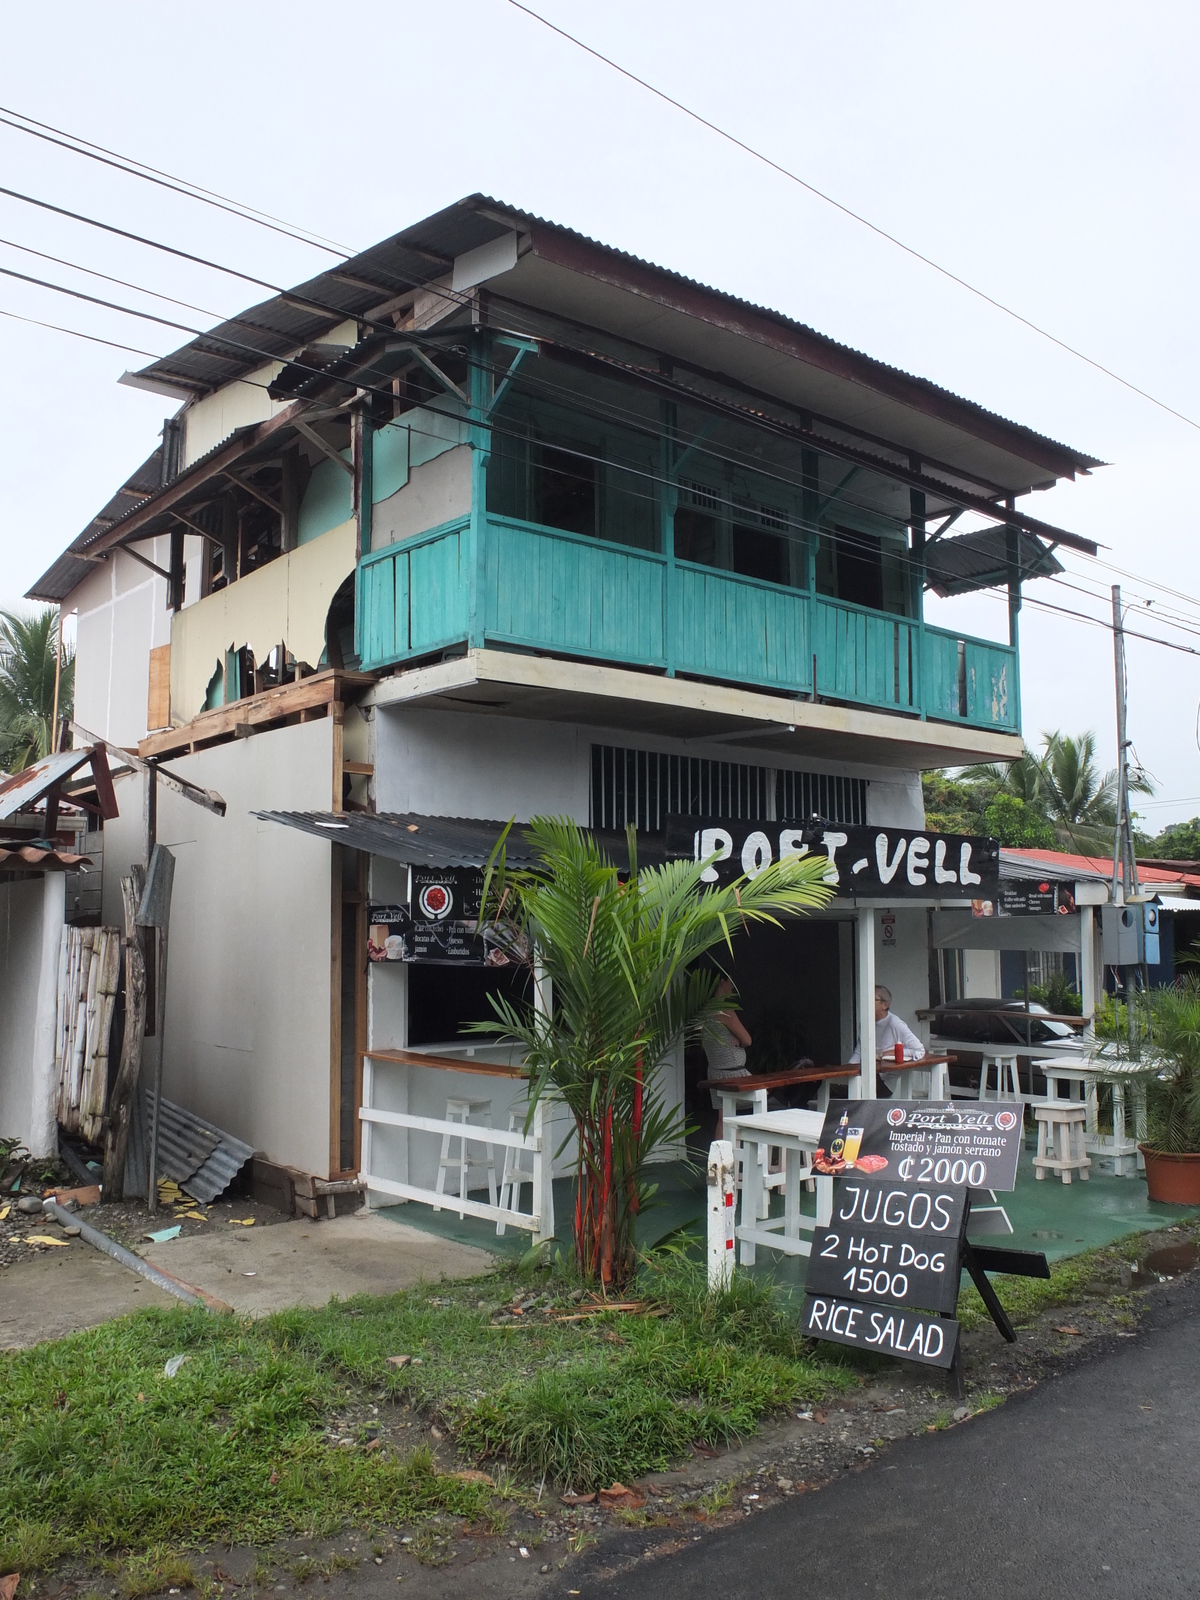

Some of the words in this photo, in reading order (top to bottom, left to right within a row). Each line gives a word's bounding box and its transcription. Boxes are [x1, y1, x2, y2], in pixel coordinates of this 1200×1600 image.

[908, 1113, 947, 1123] Port
[953, 1113, 994, 1125] Vell
[889, 1131, 925, 1143] Imperial
[935, 1132, 951, 1144] Pan
[954, 1136, 970, 1144] con
[973, 1135, 1007, 1147] tomate
[891, 1142, 924, 1152] tostado
[926, 1145, 932, 1155] y
[933, 1143, 962, 1156] jamón
[965, 1147, 1001, 1157] serrano
[839, 1186, 954, 1231] JUGOS
[820, 1234, 840, 1258] 2
[843, 1266, 908, 1298] 1500
[865, 1312, 944, 1358] SALAD
